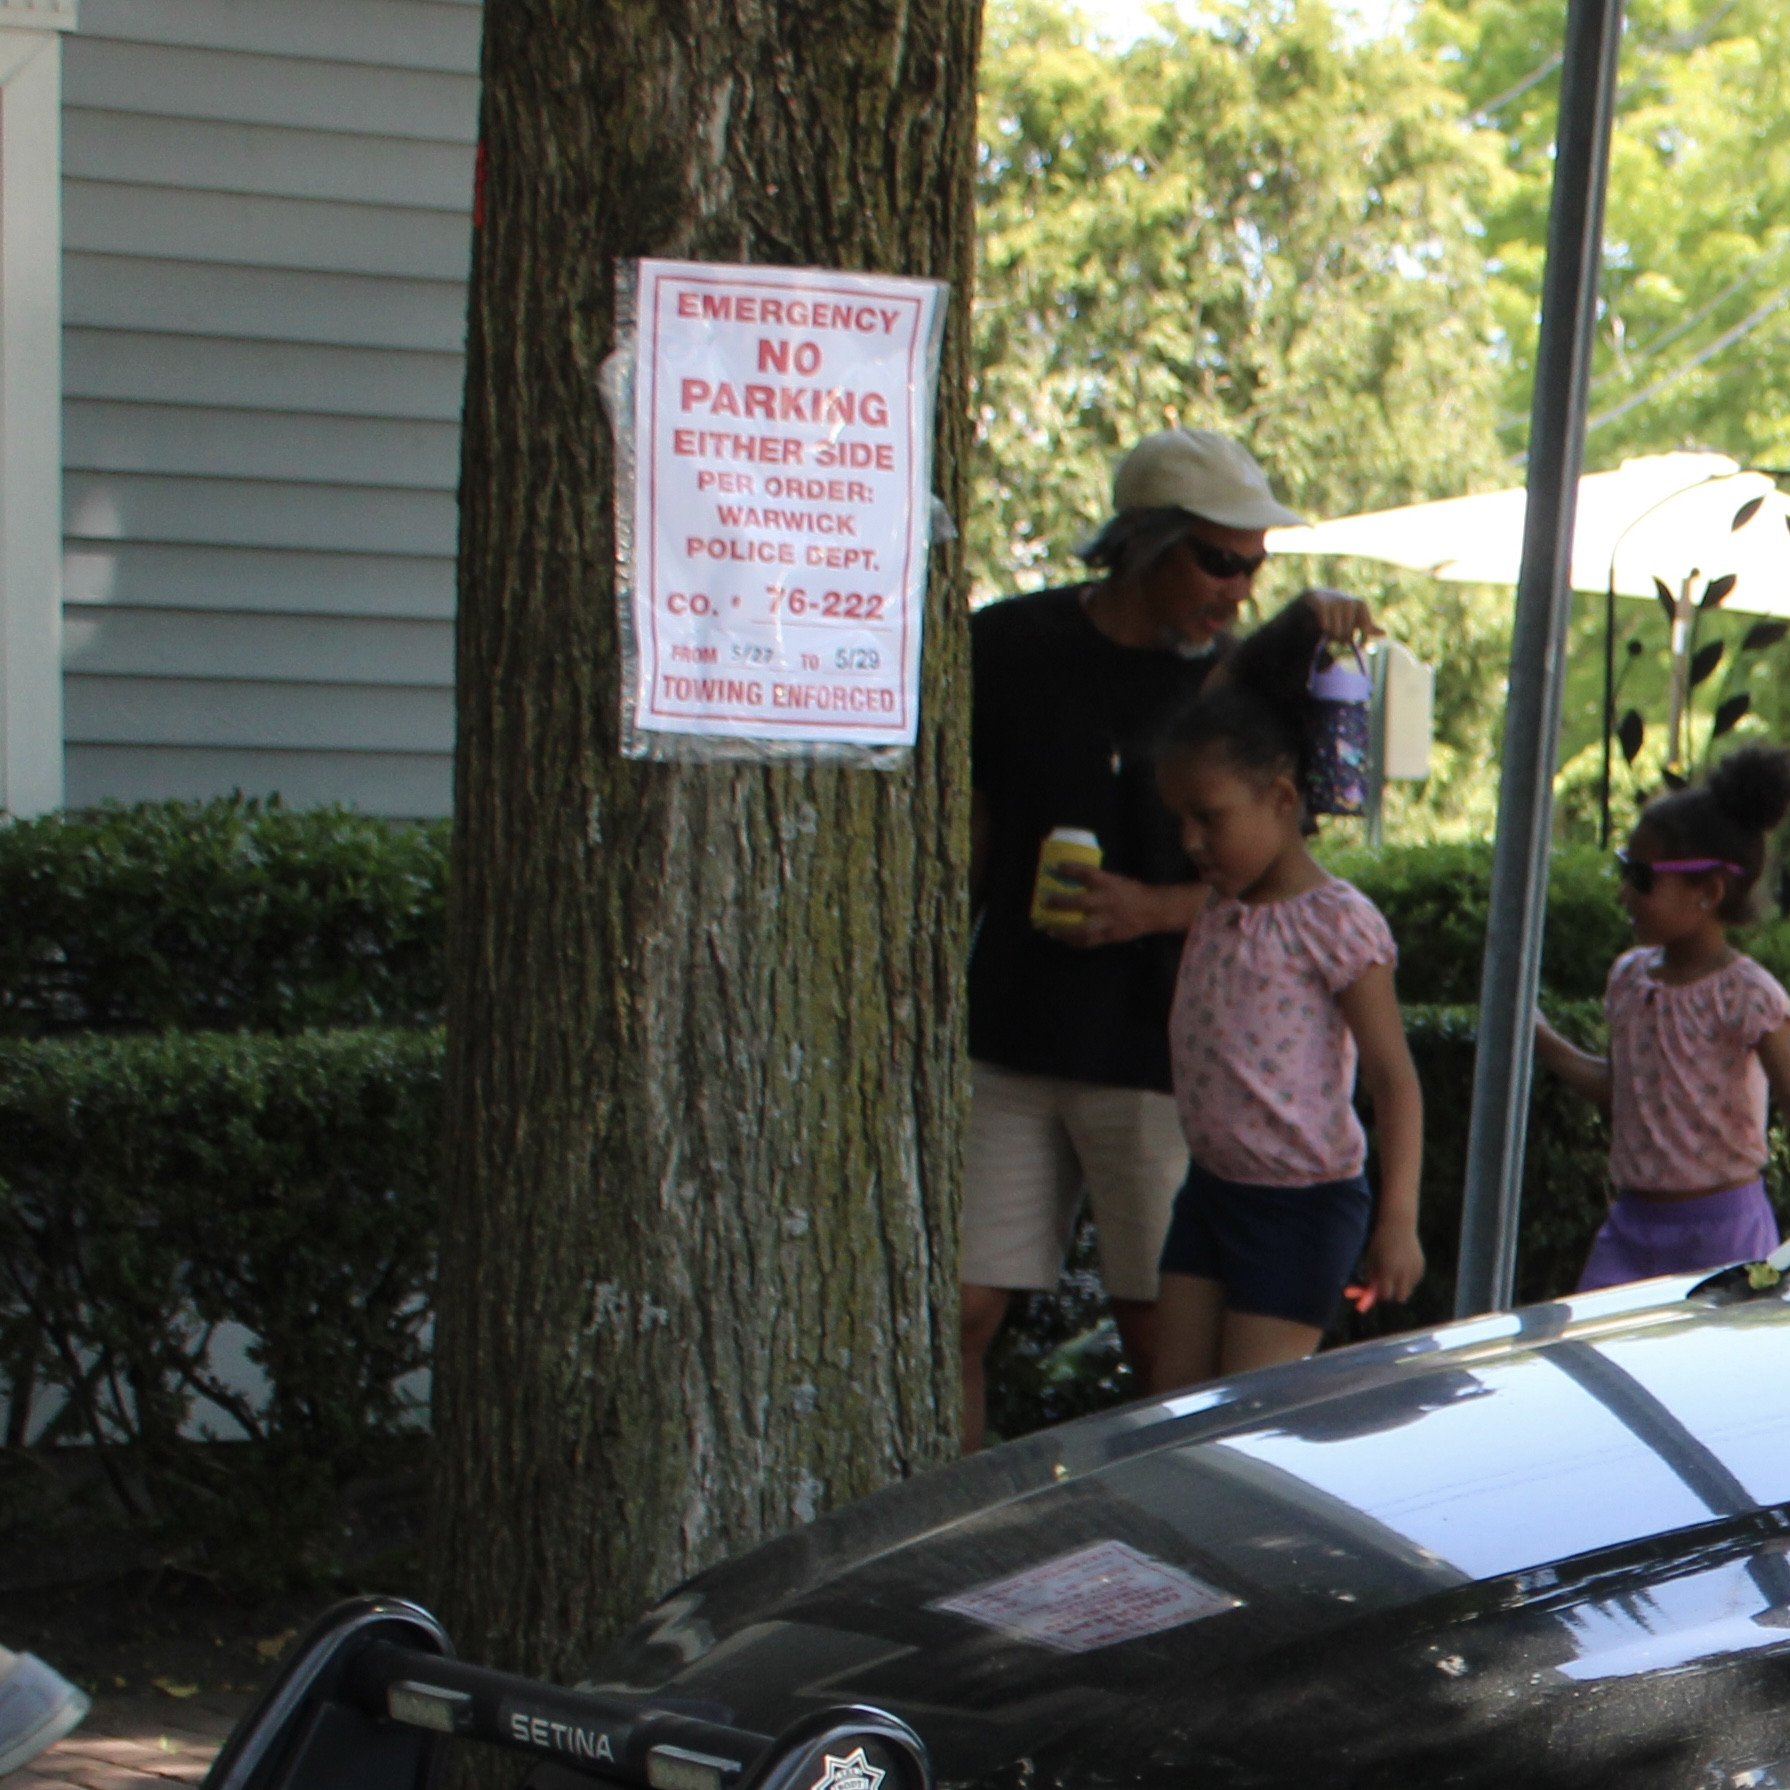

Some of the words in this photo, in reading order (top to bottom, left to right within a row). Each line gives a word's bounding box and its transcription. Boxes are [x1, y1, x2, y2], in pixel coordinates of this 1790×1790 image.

[678, 291, 901, 334] EMERGENCY
[758, 338, 823, 376] NO
[681, 378, 889, 427] PARKING
[674, 428, 804, 466] EITHER
[814, 440, 895, 471] SIDE
[698, 470, 755, 495] PER
[764, 476, 874, 503] ORDER:
[717, 504, 857, 536] WARWICK
[686, 537, 796, 564] POLICE
[806, 545, 880, 572] DEPT.
[667, 592, 719, 617] CO.
[766, 585, 885, 621] 76-222
[671, 644, 718, 664] FROM
[801, 653, 820, 671] TO
[835, 649, 880, 670] 5/29
[663, 675, 764, 706] TOWING
[772, 683, 895, 713] ENFORCED
[511, 1712, 615, 1763] SETINA
